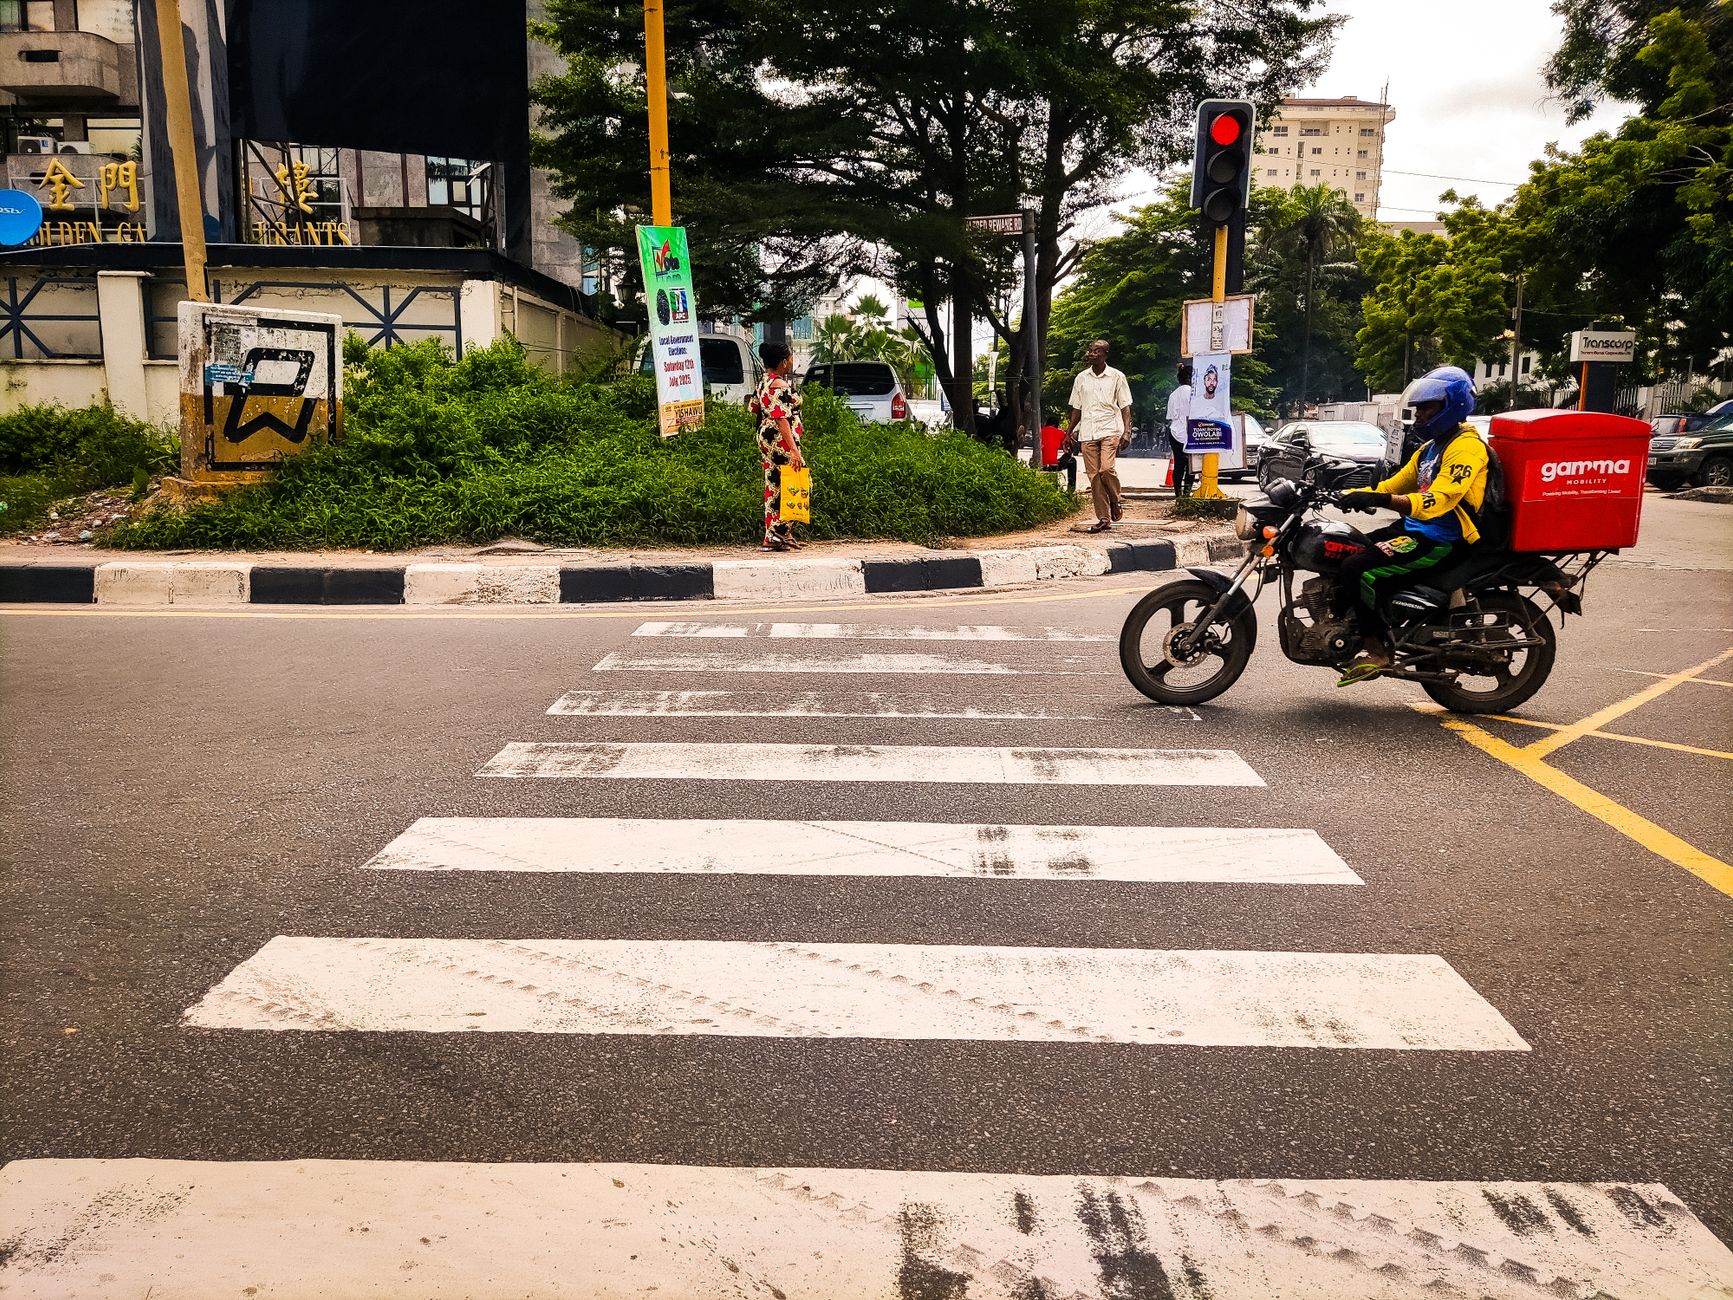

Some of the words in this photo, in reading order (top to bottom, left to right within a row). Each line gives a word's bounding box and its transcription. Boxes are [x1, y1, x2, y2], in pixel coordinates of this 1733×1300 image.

[38, 158, 140, 212] 金門
[1013, 217, 1023, 230] RD
[658, 336, 670, 346] Local
[670, 334, 694, 345] Government
[1582, 336, 1633, 352] Transcorp
[663, 360, 685, 373] Saturday
[1449, 463, 1473, 479] 126
[1541, 459, 1631, 483] gamma
